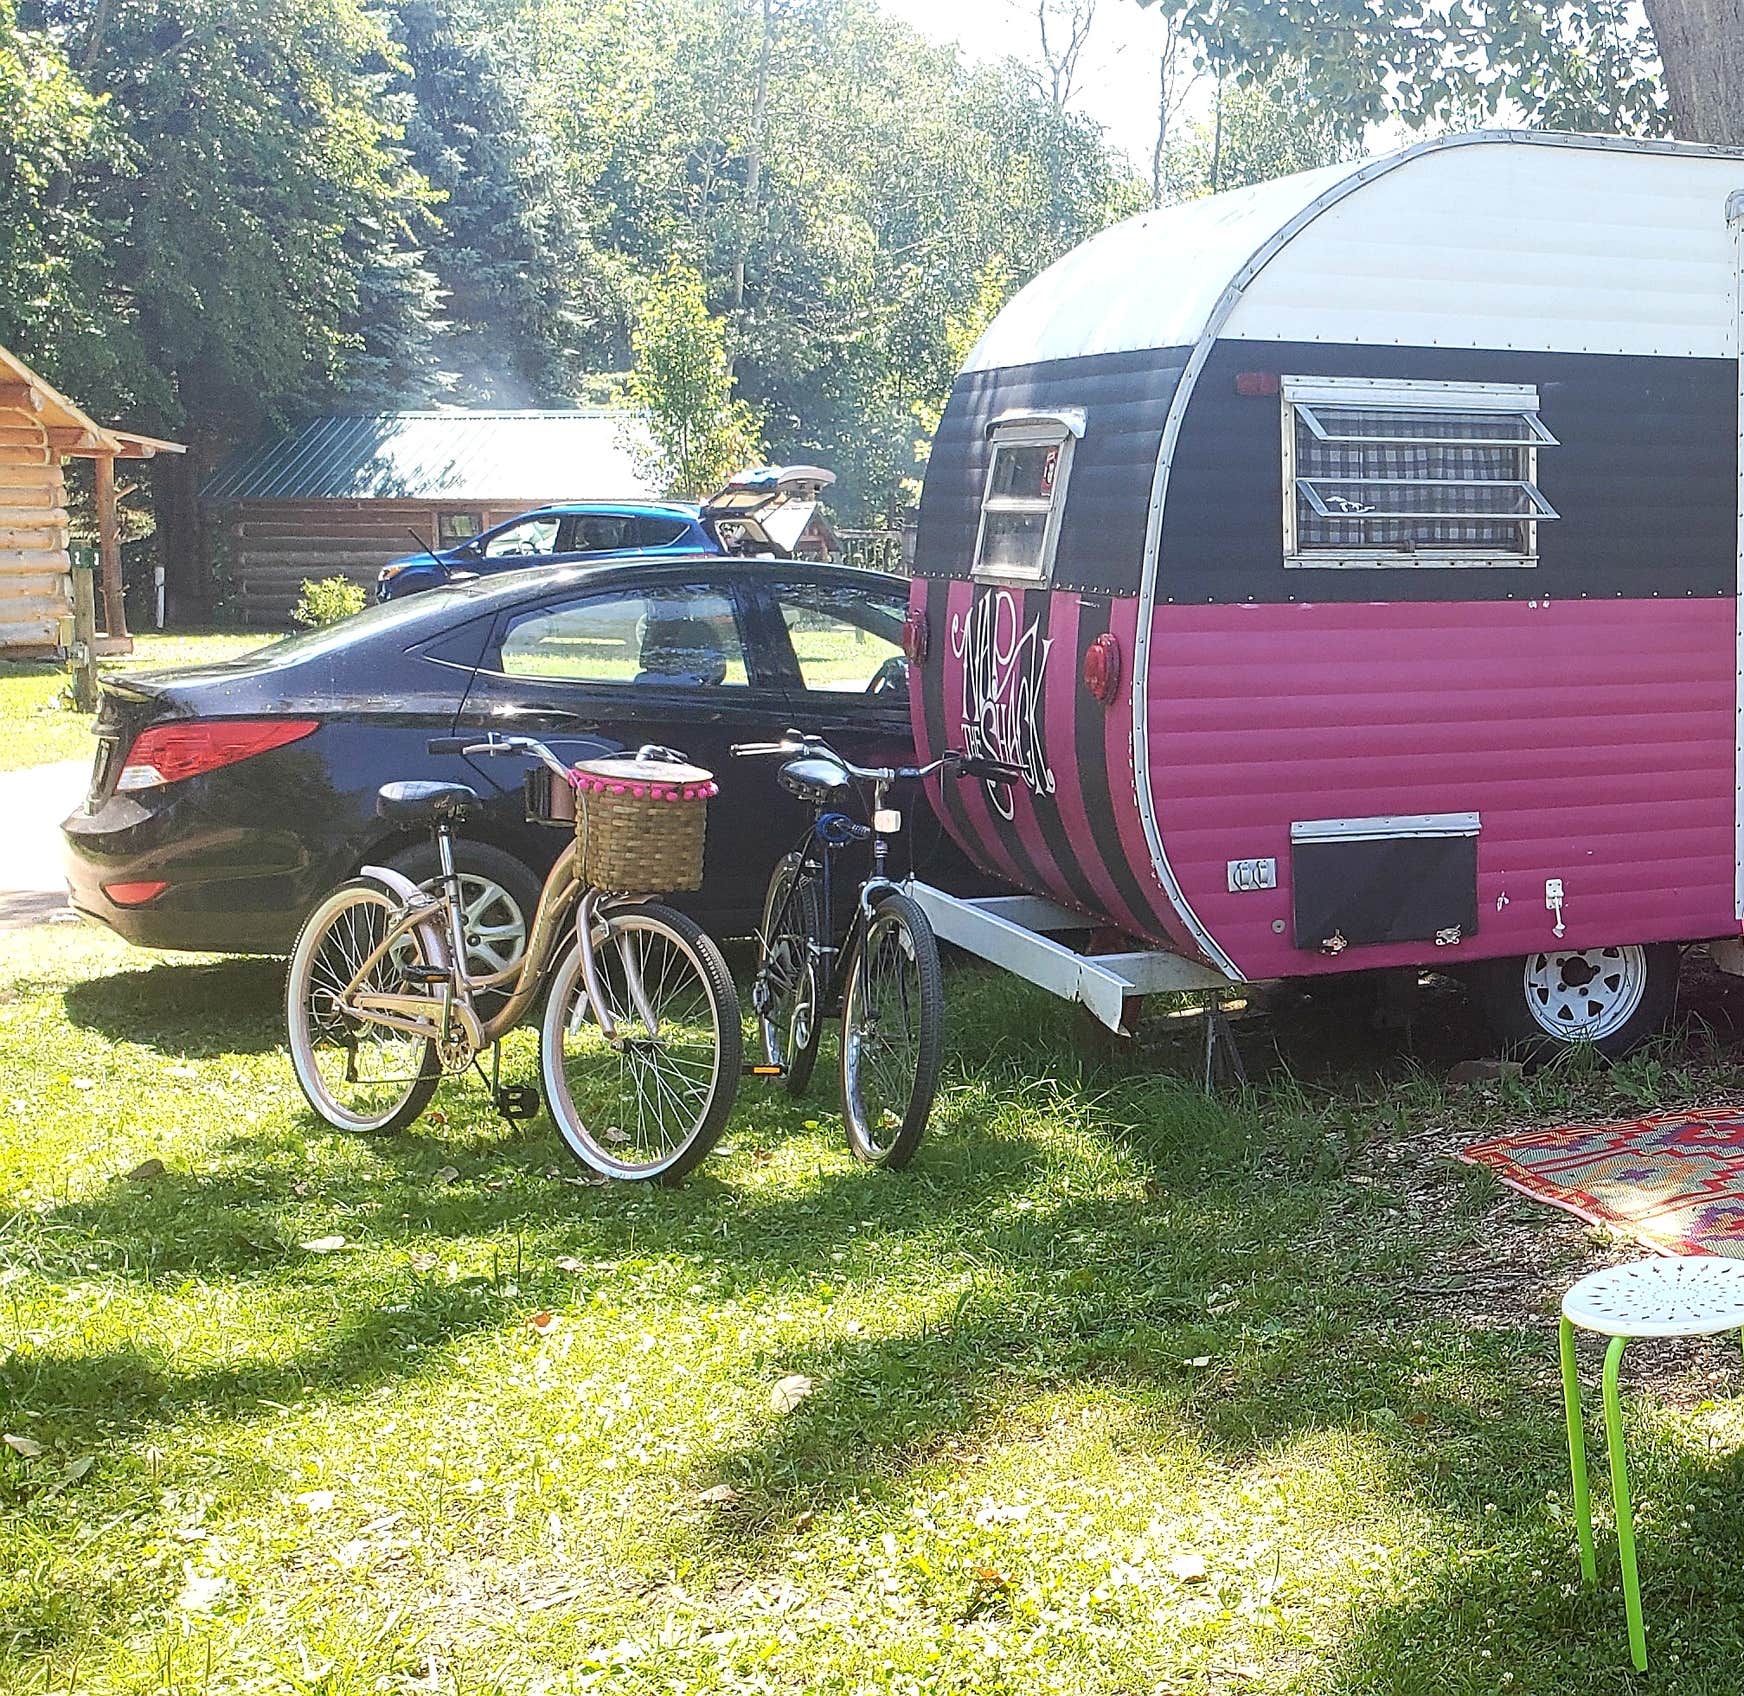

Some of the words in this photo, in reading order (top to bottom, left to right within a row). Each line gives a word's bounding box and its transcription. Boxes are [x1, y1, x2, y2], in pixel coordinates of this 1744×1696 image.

[951, 588, 1016, 722] NAP
[961, 723, 983, 760] THE
[981, 612, 1055, 821] SHACK
